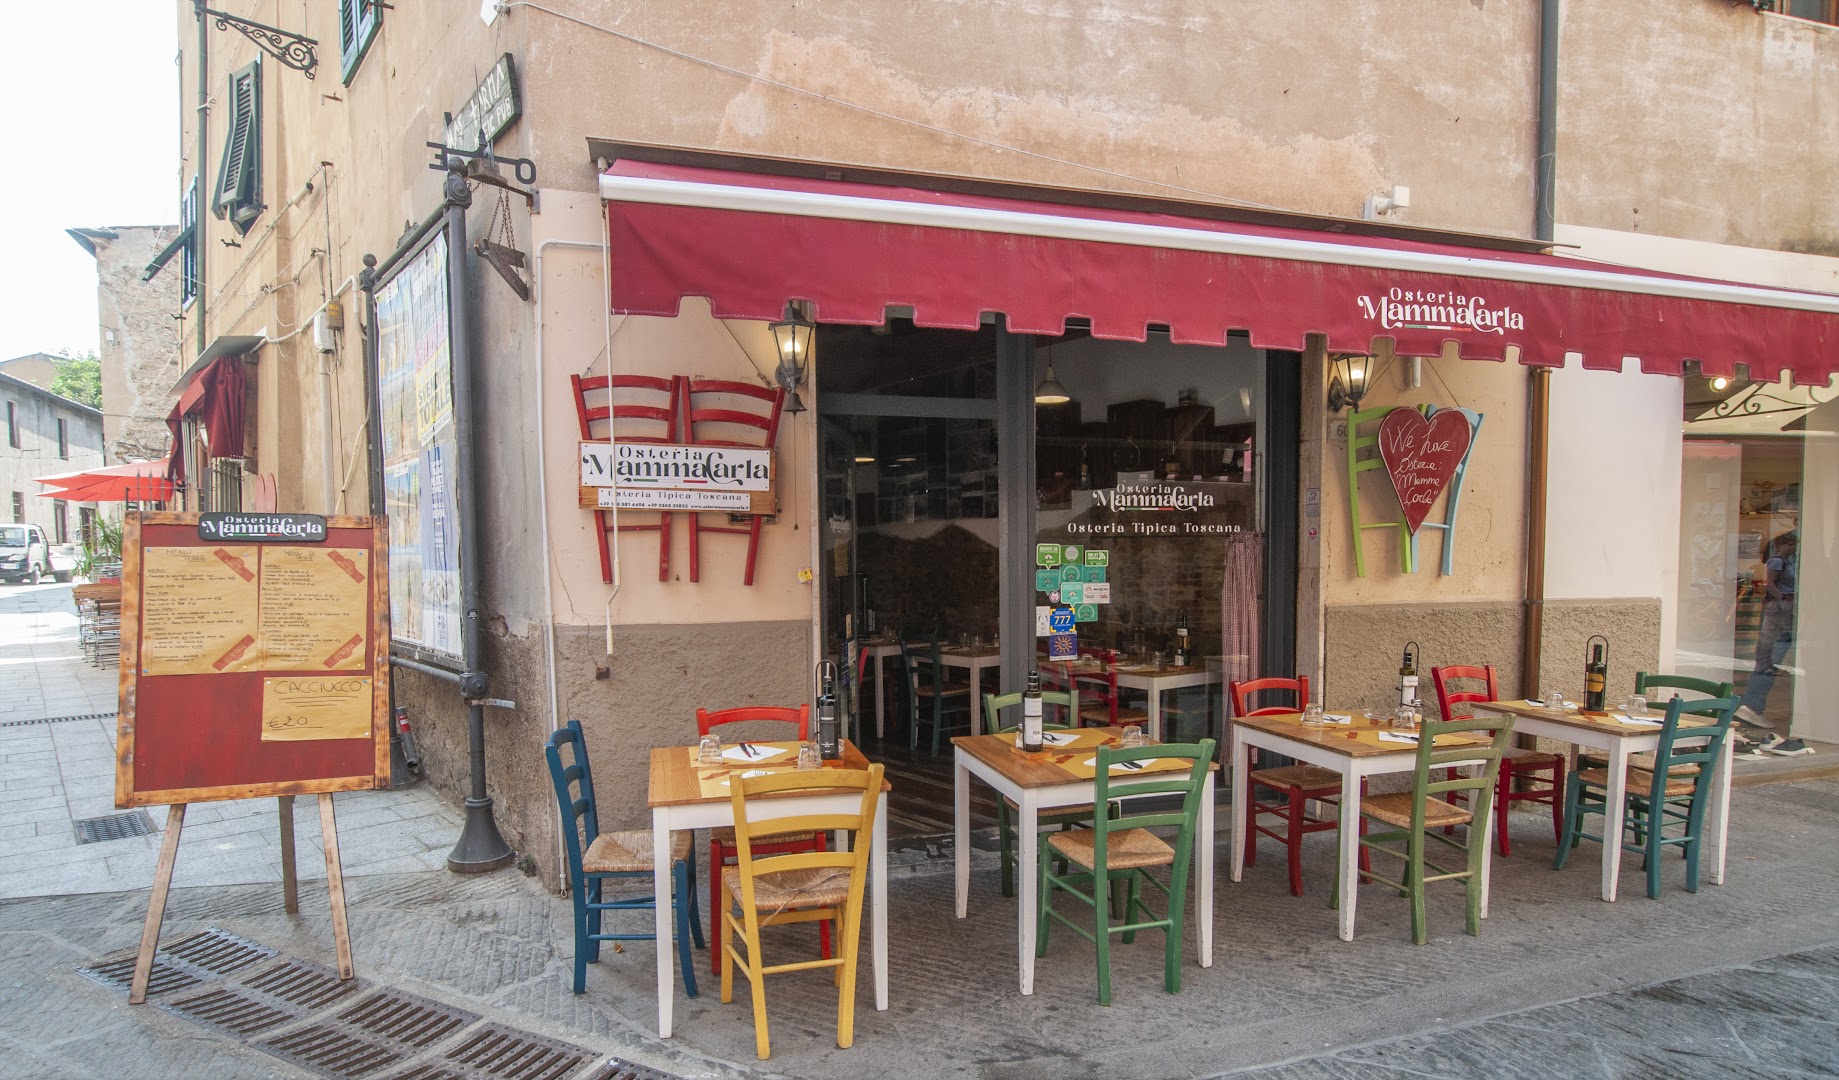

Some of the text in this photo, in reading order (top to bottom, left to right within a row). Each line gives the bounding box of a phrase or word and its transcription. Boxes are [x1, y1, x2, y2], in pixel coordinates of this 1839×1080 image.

[1390, 287, 1467, 306] Osteria
[1357, 295, 1524, 335] MammaCarla
[1387, 420, 1419, 454] We
[619, 446, 703, 460] Osteria
[582, 451, 769, 486] MammaCarla
[1116, 483, 1171, 493] Osteria
[656, 491, 691, 500] Tipica
[697, 492, 742, 501] Toscana
[1092, 486, 1214, 513] MammaCarla
[225, 515, 280, 523] Osteria
[201, 517, 322, 538] MammaCarla
[1067, 522, 1241, 536] Osteria Tipica Toscana
[1054, 615, 1071, 625] 777
[273, 680, 362, 694] CACCIUCCO
